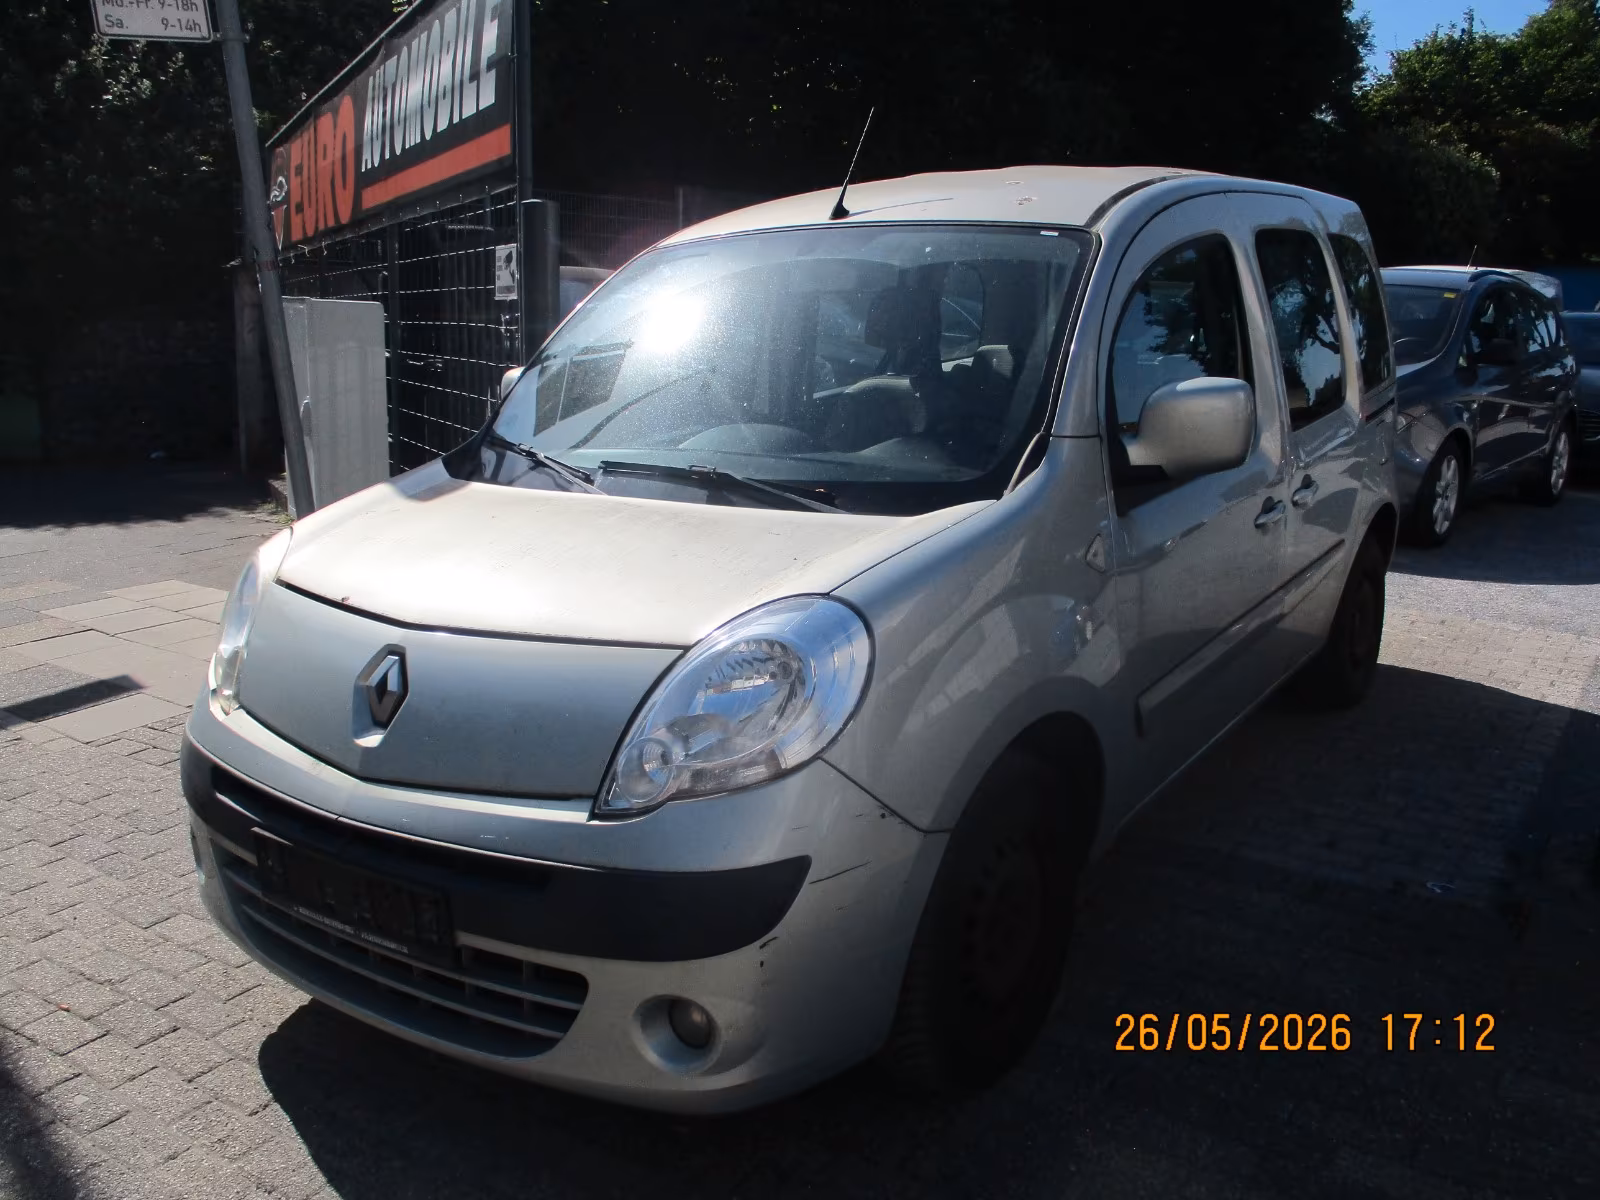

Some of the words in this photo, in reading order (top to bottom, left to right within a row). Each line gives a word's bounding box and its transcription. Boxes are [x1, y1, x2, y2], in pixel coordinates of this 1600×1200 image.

[158, 0, 199, 12] 9-18h
[104, 14, 129, 29] Sa.
[161, 17, 202, 33] 9-14h
[289, 95, 355, 241] EURO
[361, 0, 501, 172] AUTOMOBILE
